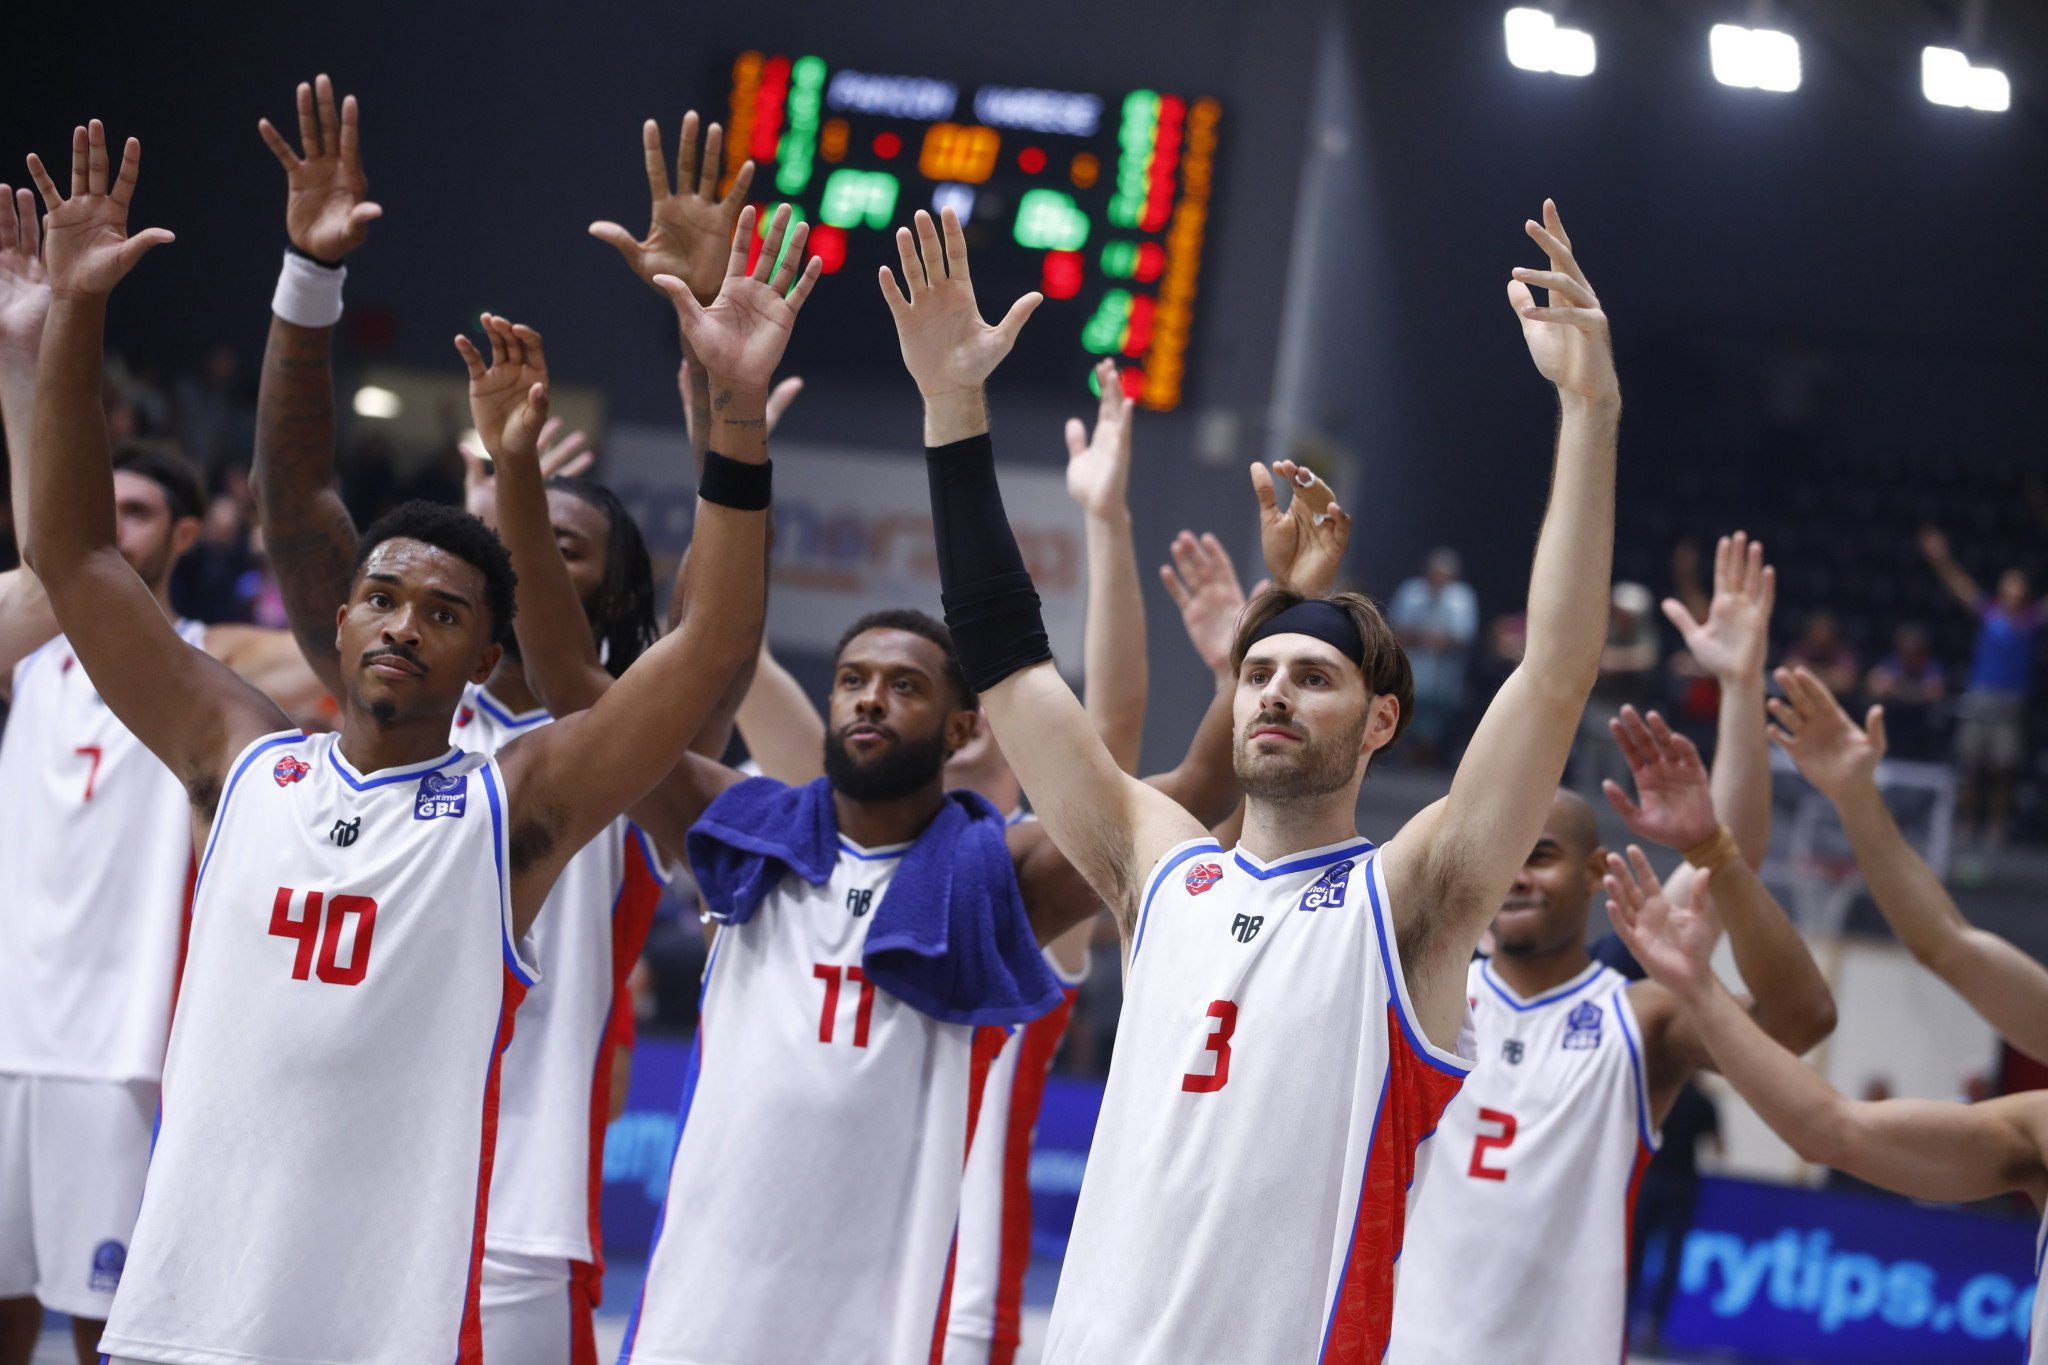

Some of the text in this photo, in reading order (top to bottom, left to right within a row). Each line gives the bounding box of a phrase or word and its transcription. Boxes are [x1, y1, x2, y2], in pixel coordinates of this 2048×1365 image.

[74, 746, 101, 802] 7
[418, 801, 461, 817] GBL
[846, 888, 873, 917] AB
[1305, 888, 1341, 908] GL
[268, 886, 378, 986] 40
[1231, 912, 1265, 944] AB
[1181, 999, 1239, 1093] 3
[1468, 1107, 1518, 1182] 2
